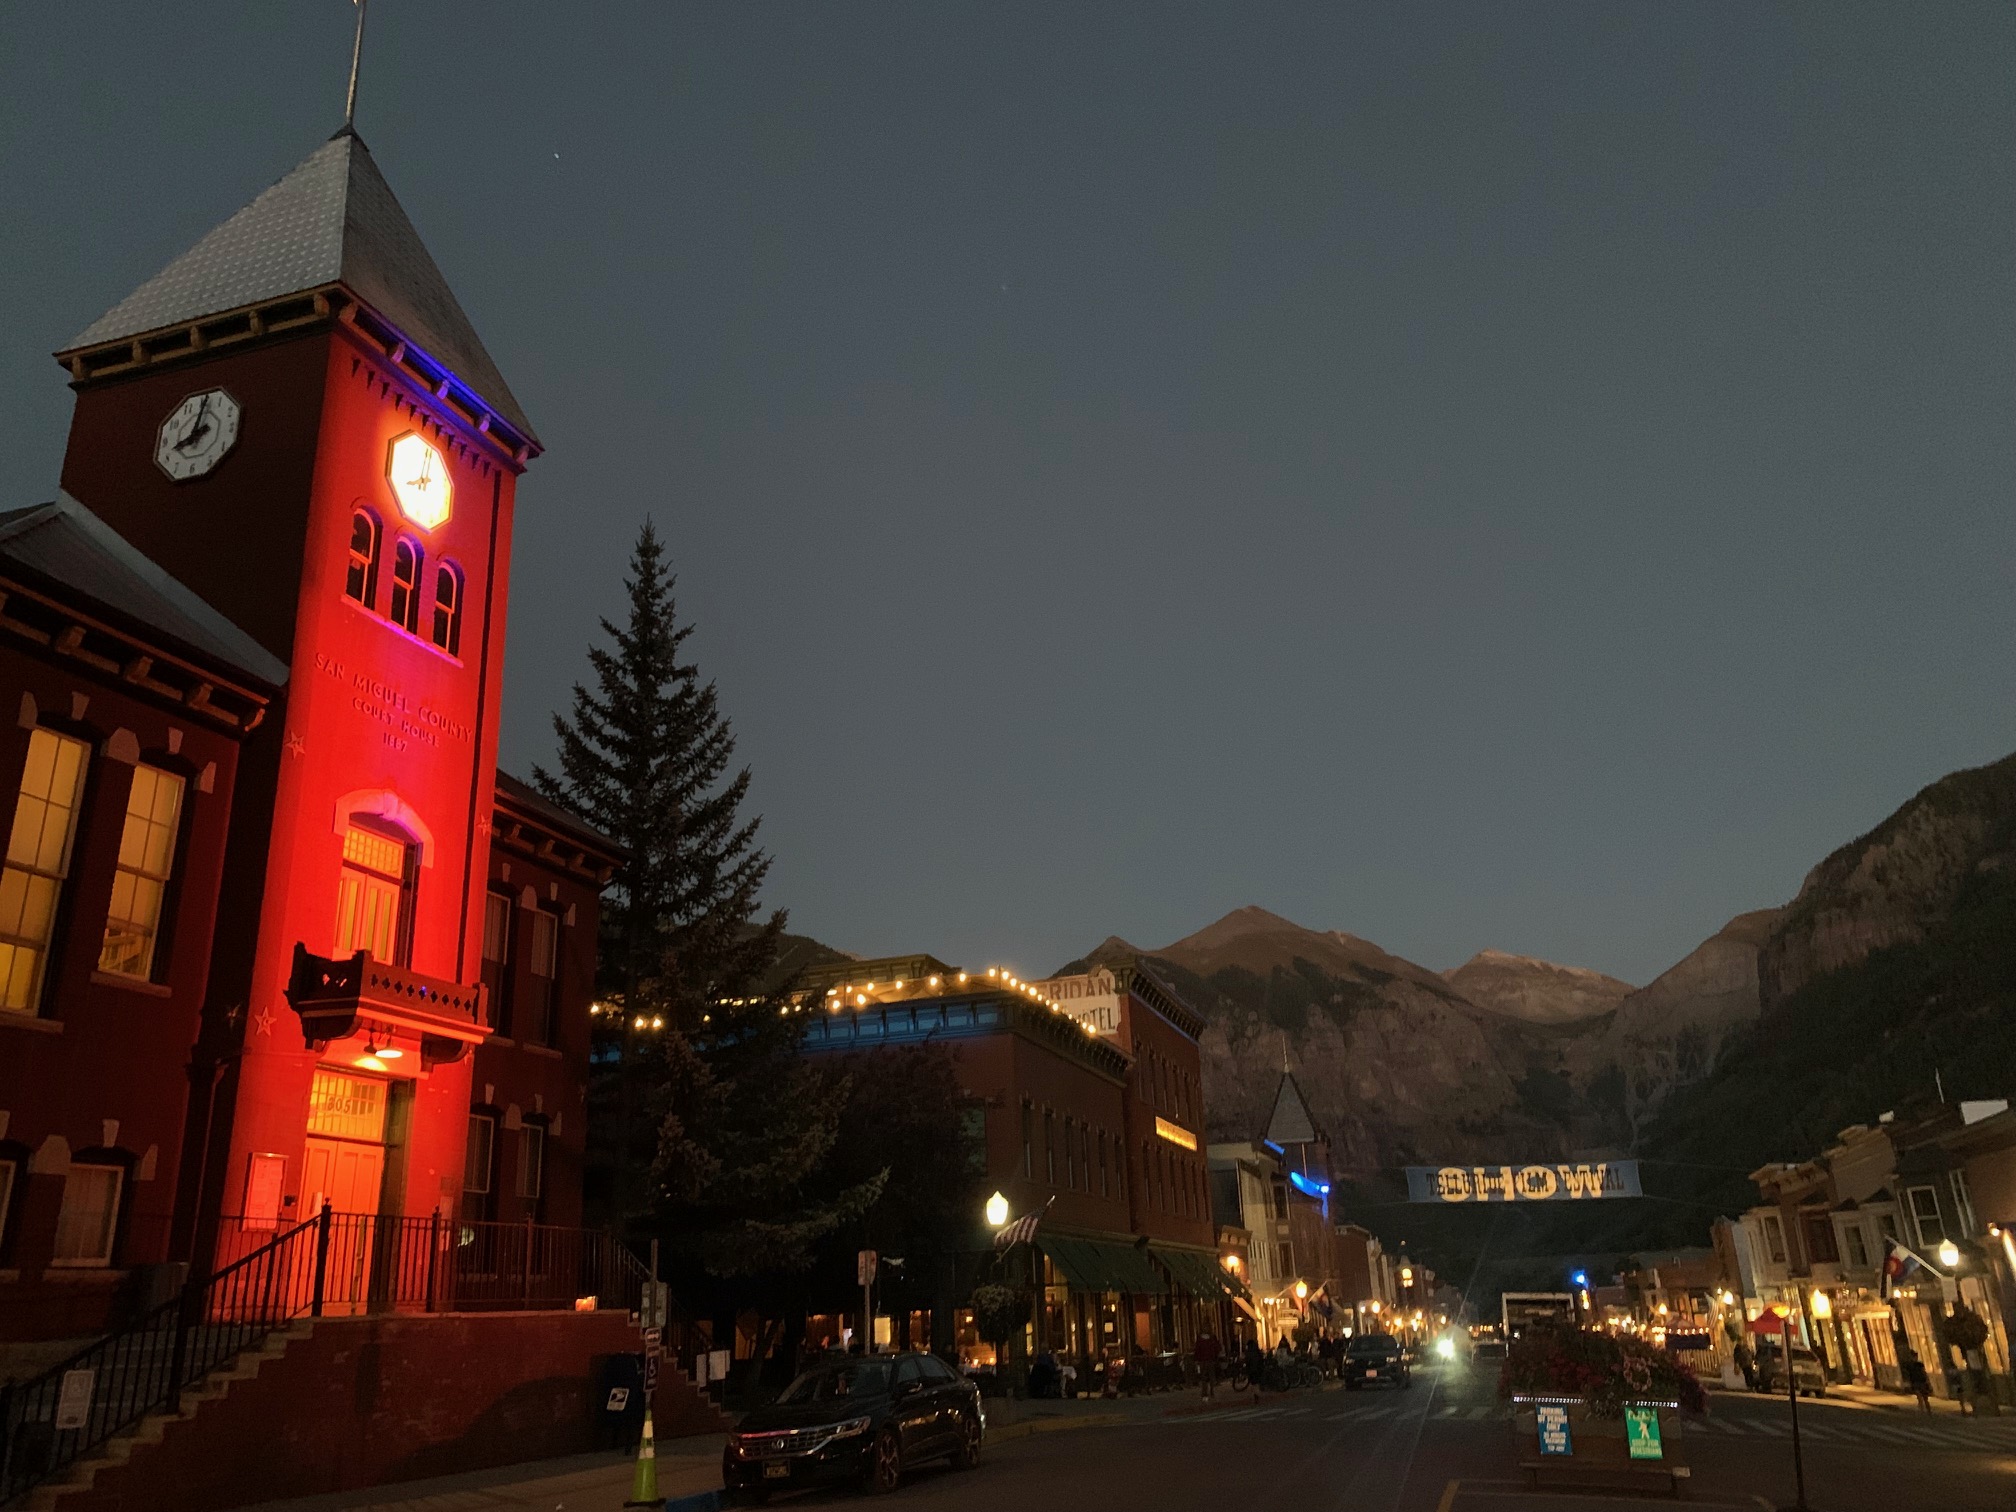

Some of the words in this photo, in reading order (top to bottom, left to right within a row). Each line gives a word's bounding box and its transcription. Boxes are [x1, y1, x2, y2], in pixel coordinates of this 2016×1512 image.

[314, 651, 345, 680] SAN
[353, 673, 410, 714] MIGUEL
[419, 706, 472, 743] COUNTY
[352, 697, 395, 726] COURT
[401, 720, 440, 748] HOUSE
[383, 732, 408, 752] 1887
